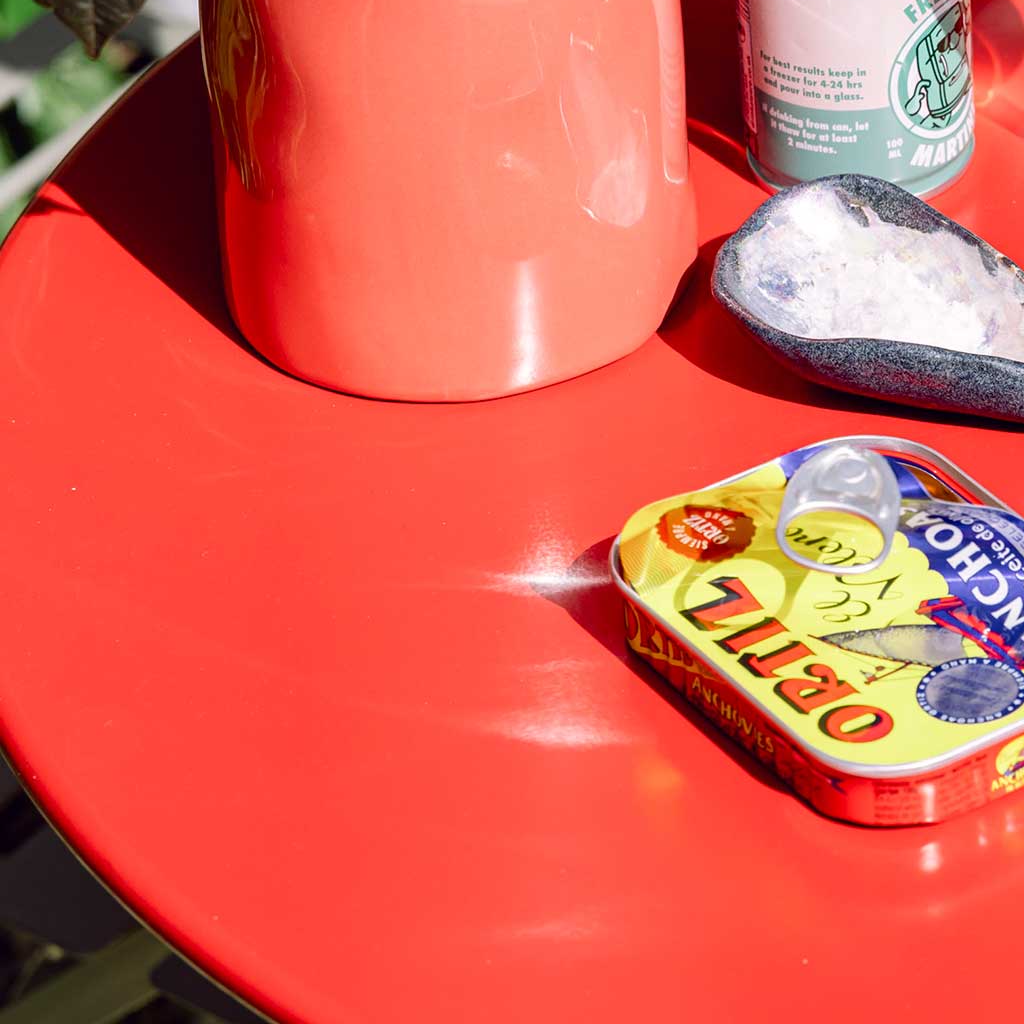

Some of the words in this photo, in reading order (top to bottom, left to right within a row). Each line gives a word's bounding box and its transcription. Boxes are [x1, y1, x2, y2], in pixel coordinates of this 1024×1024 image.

[770, 66, 801, 83] freezer
[803, 76, 818, 87] for
[820, 80, 844, 89] 4-24
[846, 79, 863, 89] hrs
[773, 56, 791, 70] best
[793, 65, 826, 77] results
[828, 68, 854, 79] keep
[857, 67, 867, 77] in
[764, 77, 778, 89] and
[780, 83, 800, 95] pour
[802, 87, 822, 99] into
[834, 93, 864, 103] glass.
[769, 106, 804, 128] drinking
[806, 117, 830, 131] from
[832, 124, 852, 133] can,
[855, 121, 870, 131] let
[778, 122, 801, 137] thaw
[802, 129, 817, 140] for
[819, 133, 830, 142] at
[832, 133, 858, 143] least
[786, 136, 794, 147] 2
[795, 140, 838, 154] minutes.
[886, 137, 904, 149] 100
[910, 104, 974, 168] MARTIN
[682, 514, 730, 545] ORTIZ
[971, 522, 995, 542] de
[813, 589, 872, 624] El
[678, 576, 895, 744] ORTIZ
[692, 676, 775, 753] ANCHOVIES
